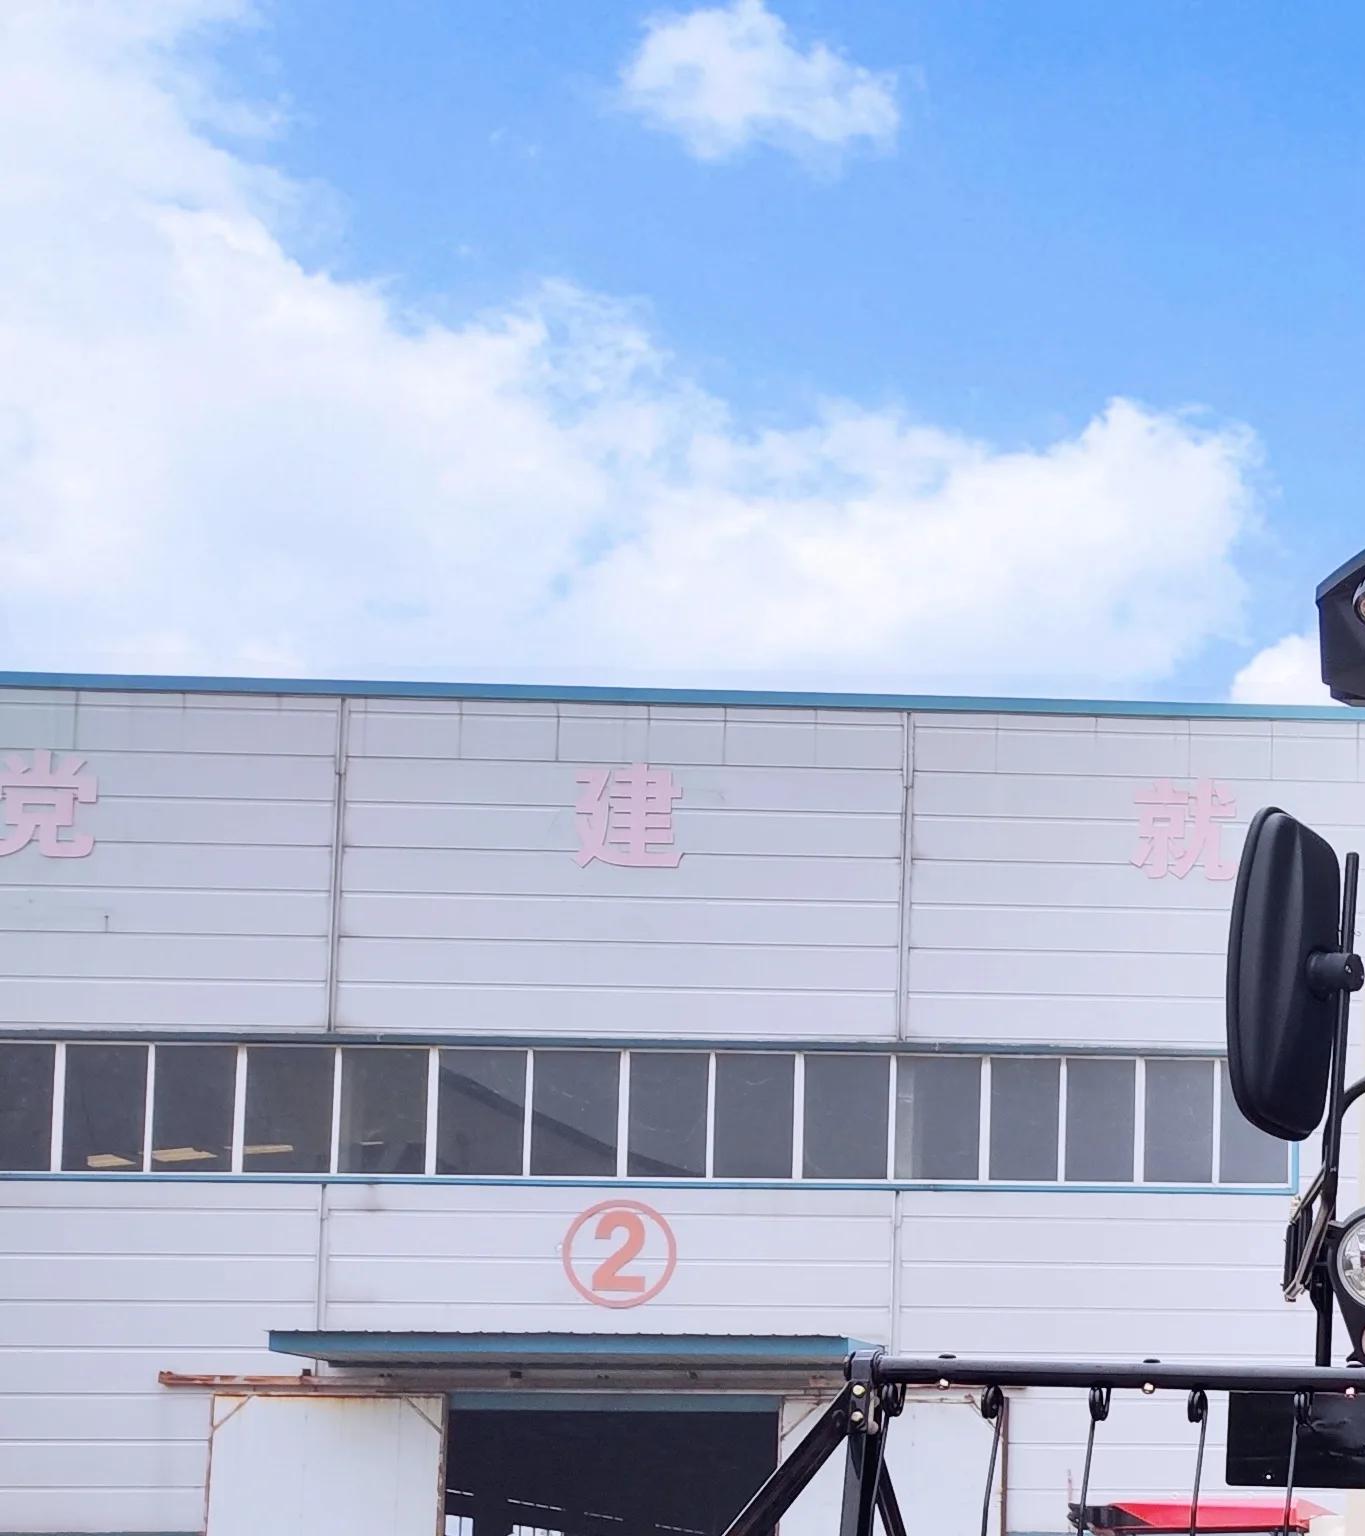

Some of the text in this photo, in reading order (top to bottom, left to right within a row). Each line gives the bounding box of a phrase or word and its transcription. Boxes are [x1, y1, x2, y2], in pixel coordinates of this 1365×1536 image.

[0, 748, 1238, 881] 党 建 就
